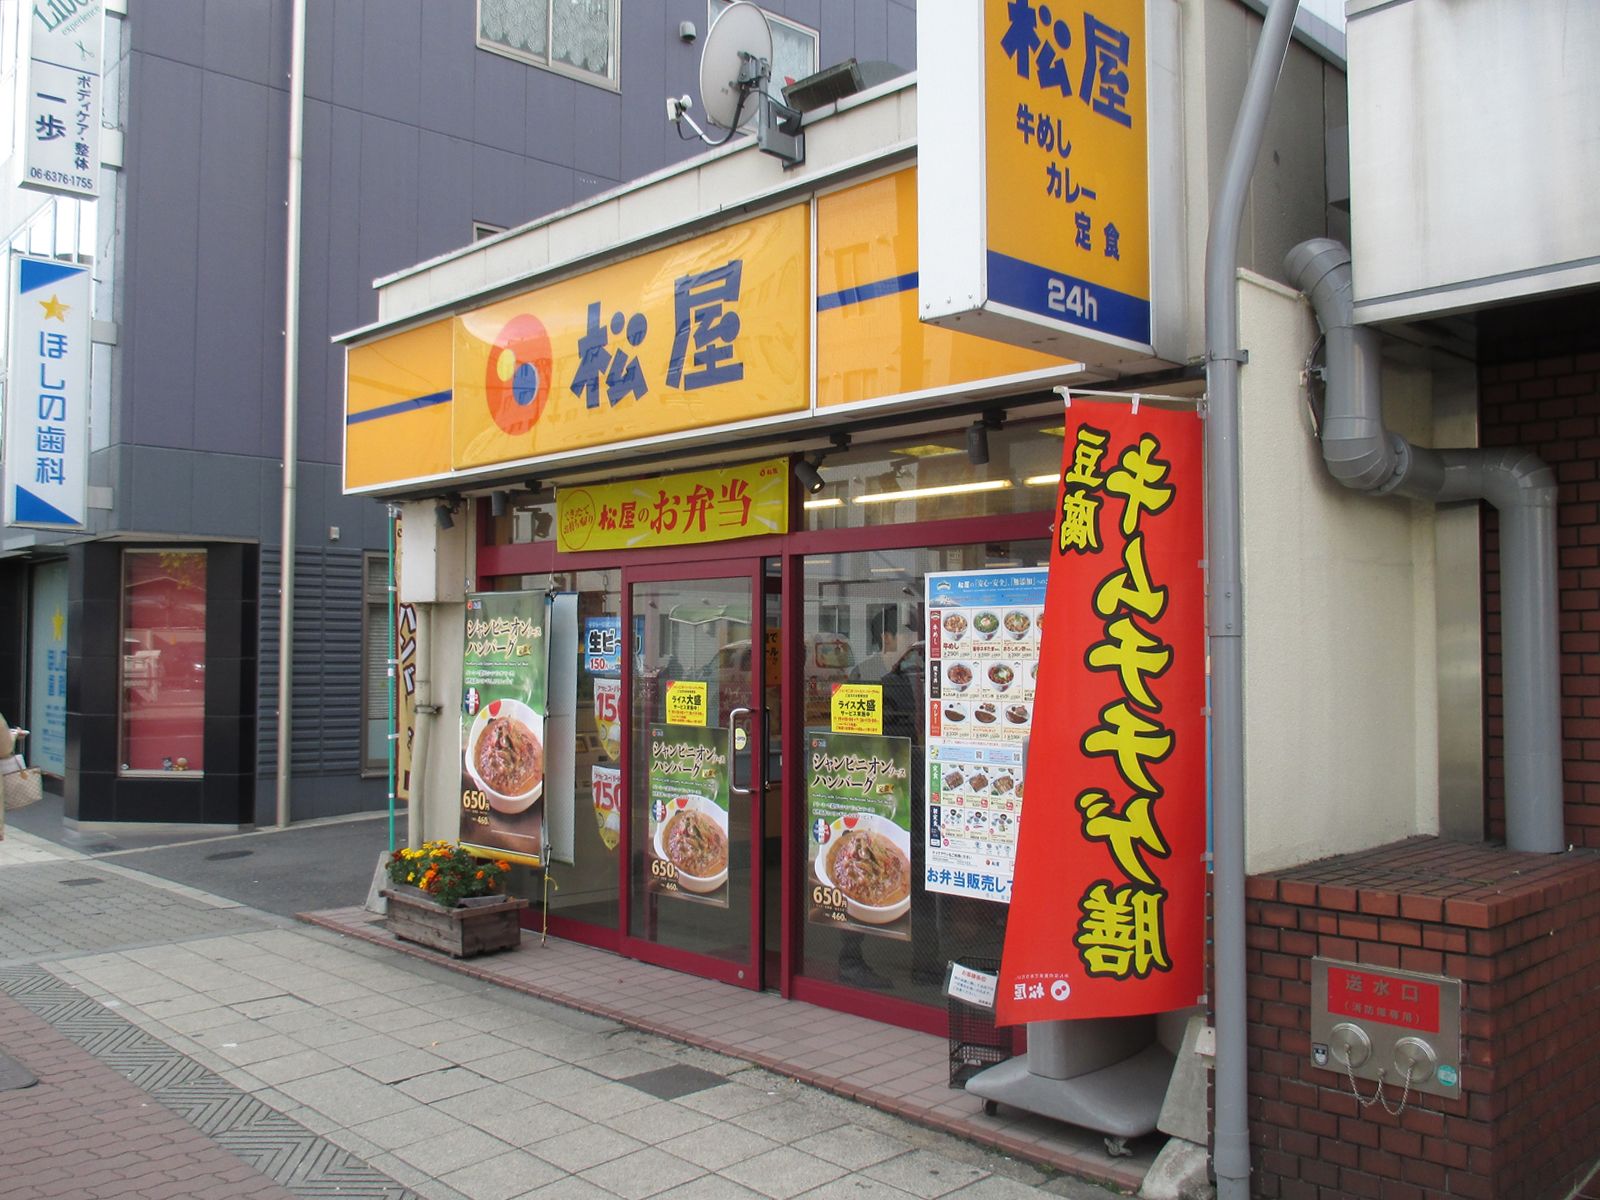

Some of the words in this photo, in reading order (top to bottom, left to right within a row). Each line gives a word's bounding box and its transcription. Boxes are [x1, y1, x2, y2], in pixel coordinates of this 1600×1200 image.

[1000, 0, 1132, 129] 松屋
[36, 92, 67, 141] 一歩
[1016, 103, 1072, 158] 牛めし
[30, 167, 93, 189] 06-6376-1755
[1046, 161, 1097, 203] カレー
[1074, 211, 1120, 261] 定食
[1047, 278, 1098, 322] 24h
[569, 259, 744, 409] 松屋
[36, 331, 68, 485] ほしの歯科
[598, 479, 752, 534] 松屋のお弁当
[465, 638, 518, 660] ハンバーグ
[671, 694, 702, 707] ライス大盛
[838, 698, 876, 712] ライス大盛
[651, 759, 703, 780] ハンバーグ
[811, 772, 878, 796] ハンバーグ
[813, 885, 848, 908] 650円
[1345, 974, 1419, 1002] 送水口
